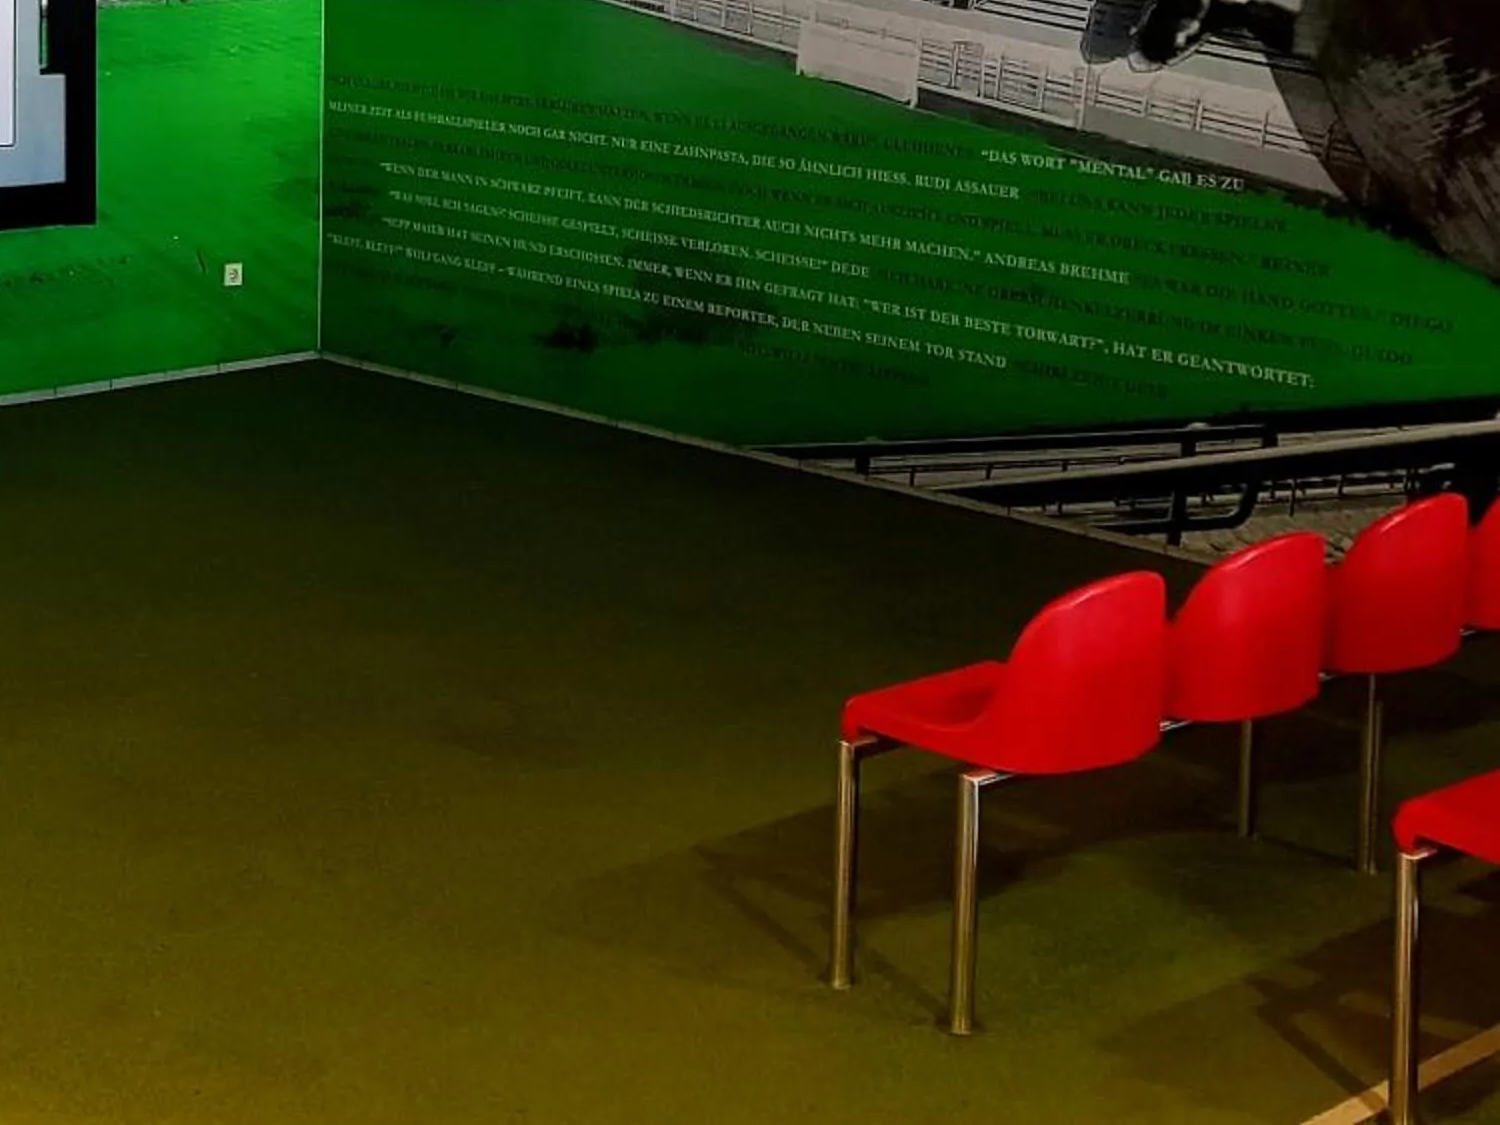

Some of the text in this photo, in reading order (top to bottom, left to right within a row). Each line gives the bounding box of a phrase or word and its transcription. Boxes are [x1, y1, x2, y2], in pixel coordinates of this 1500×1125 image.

[329, 99, 367, 114] MEINER
[370, 105, 391, 118] ZEIT
[396, 108, 412, 120] ALS
[508, 122, 540, 137] NOCH
[543, 127, 565, 140] GAR
[611, 135, 636, 149] NUR
[640, 138, 669, 154] EINE
[752, 152, 775, 168] DIE
[778, 156, 795, 170] SO
[798, 157, 861, 179] ÄHNLICH
[914, 173, 950, 190] RUDI
[954, 178, 1019, 199] ASSAUER
[1021, 152, 1064, 170] WORT
[1159, 167, 1191, 186] GAB
[1197, 172, 1216, 188] ES
[1220, 175, 1244, 192] ZU
[417, 165, 439, 180] DER
[441, 169, 472, 184] MANN
[475, 175, 487, 187] IN
[489, 176, 541, 195] SCHWARZ
[588, 192, 621, 207] KANN
[624, 196, 648, 212] DER
[652, 201, 760, 229] SCHIEDSRICHTER
[765, 218, 800, 235] AUCH
[804, 223, 856, 244] NICHTS
[859, 231, 901, 250] MEHR
[984, 250, 1055, 273] ANDREAS
[1059, 261, 1130, 285] BREHME
[442, 197, 461, 211] ICH
[508, 208, 559, 227] SCHEISSE
[621, 226, 678, 247] SCHEISSE
[405, 246, 462, 267] WOLFGANG
[464, 256, 495, 274] KLEFF
[565, 275, 599, 293] EINES
[601, 282, 640, 301] SPIELS
[643, 290, 659, 304] ZU
[662, 293, 704, 312] EINEM
[781, 315, 809, 332] DER
[812, 321, 861, 342] NEBEN
[865, 330, 920, 353] SEINEM
[925, 341, 954, 359] TOR
[958, 347, 1006, 369] STAND
[412, 220, 444, 236] MAIER
[447, 226, 467, 240] HAT
[470, 230, 510, 248] SEINEN
[513, 237, 546, 254] HUND
[673, 265, 712, 283] WENN
[715, 272, 732, 287] ER
[735, 275, 760, 292] IHN
[764, 280, 823, 303] GEFRAGT
[904, 304, 926, 320] IST
[930, 309, 959, 326] DER
[963, 314, 1010, 335] BESTE
[1112, 340, 1147, 359] HAT
[1151, 347, 1173, 364] ER
